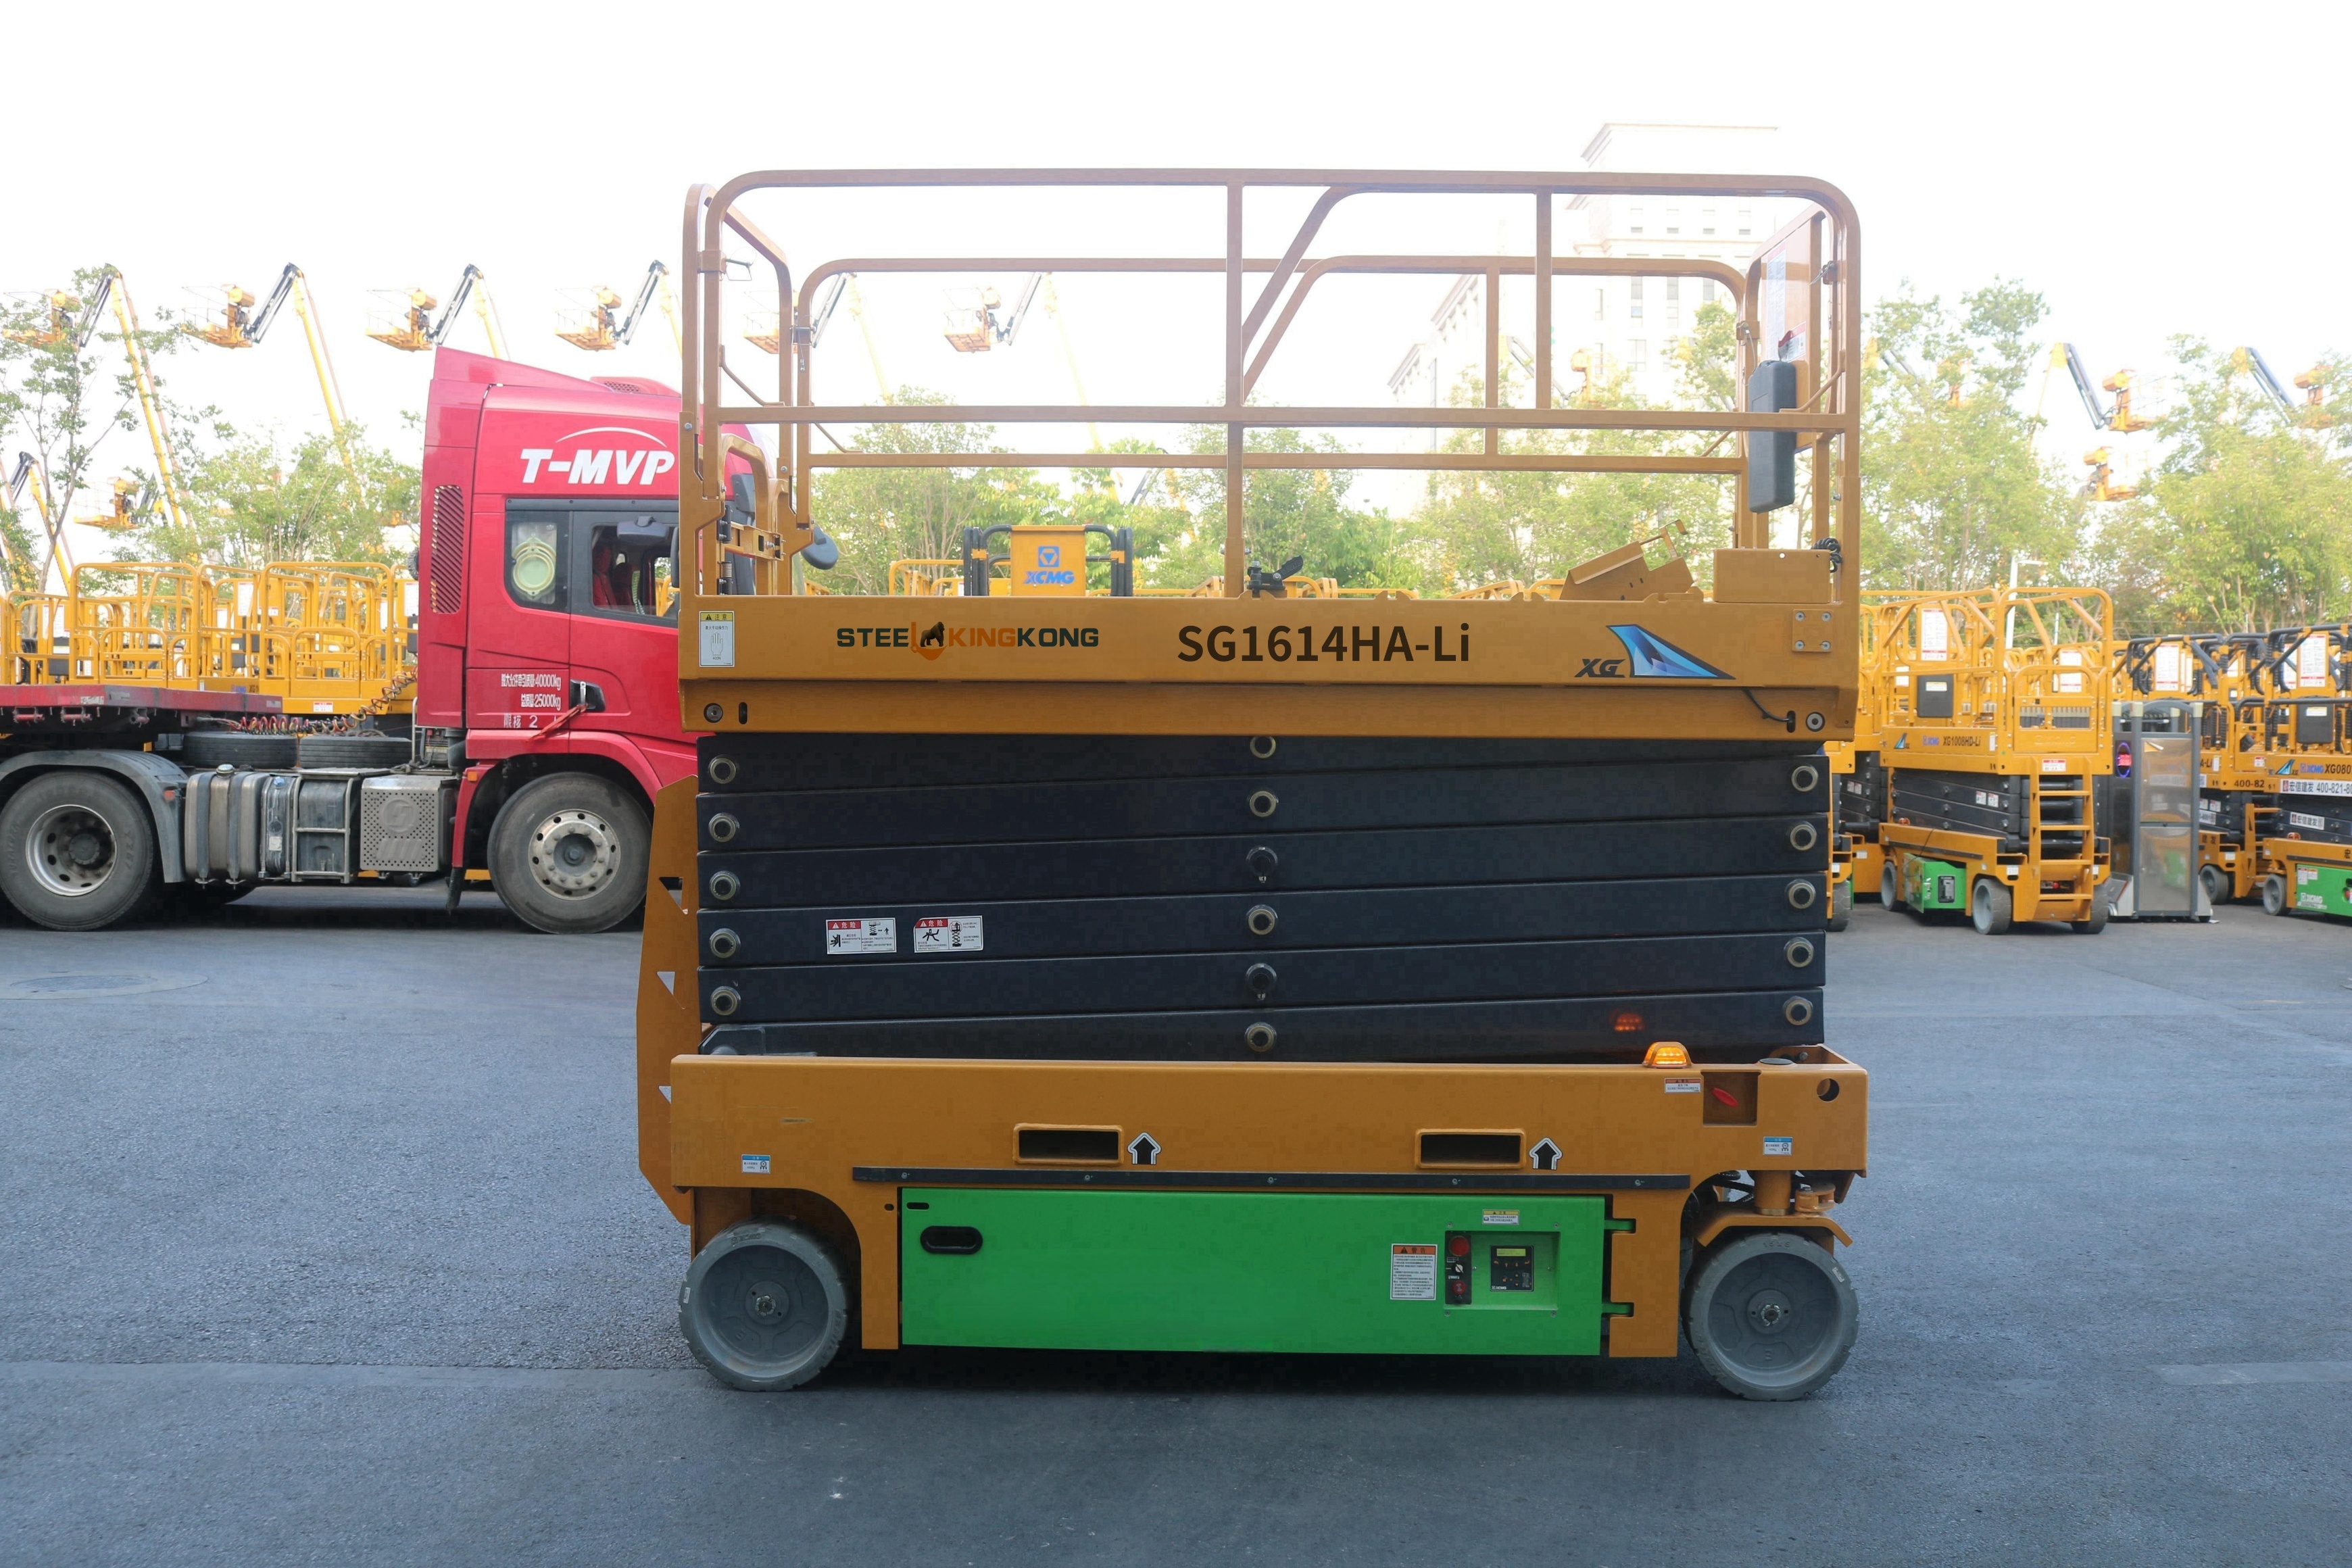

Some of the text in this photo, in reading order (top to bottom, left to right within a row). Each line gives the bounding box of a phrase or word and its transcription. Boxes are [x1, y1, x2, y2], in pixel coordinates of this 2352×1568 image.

[520, 448, 675, 485] T-MVP
[1023, 570, 1075, 585] XCMG
[1177, 622, 1469, 662] SG1614HA-Li
[1574, 658, 1626, 679] XG
[529, 715, 538, 728] 2
[2325, 764, 2352, 775] XG080
[2289, 781, 2313, 793] 宏信建发
